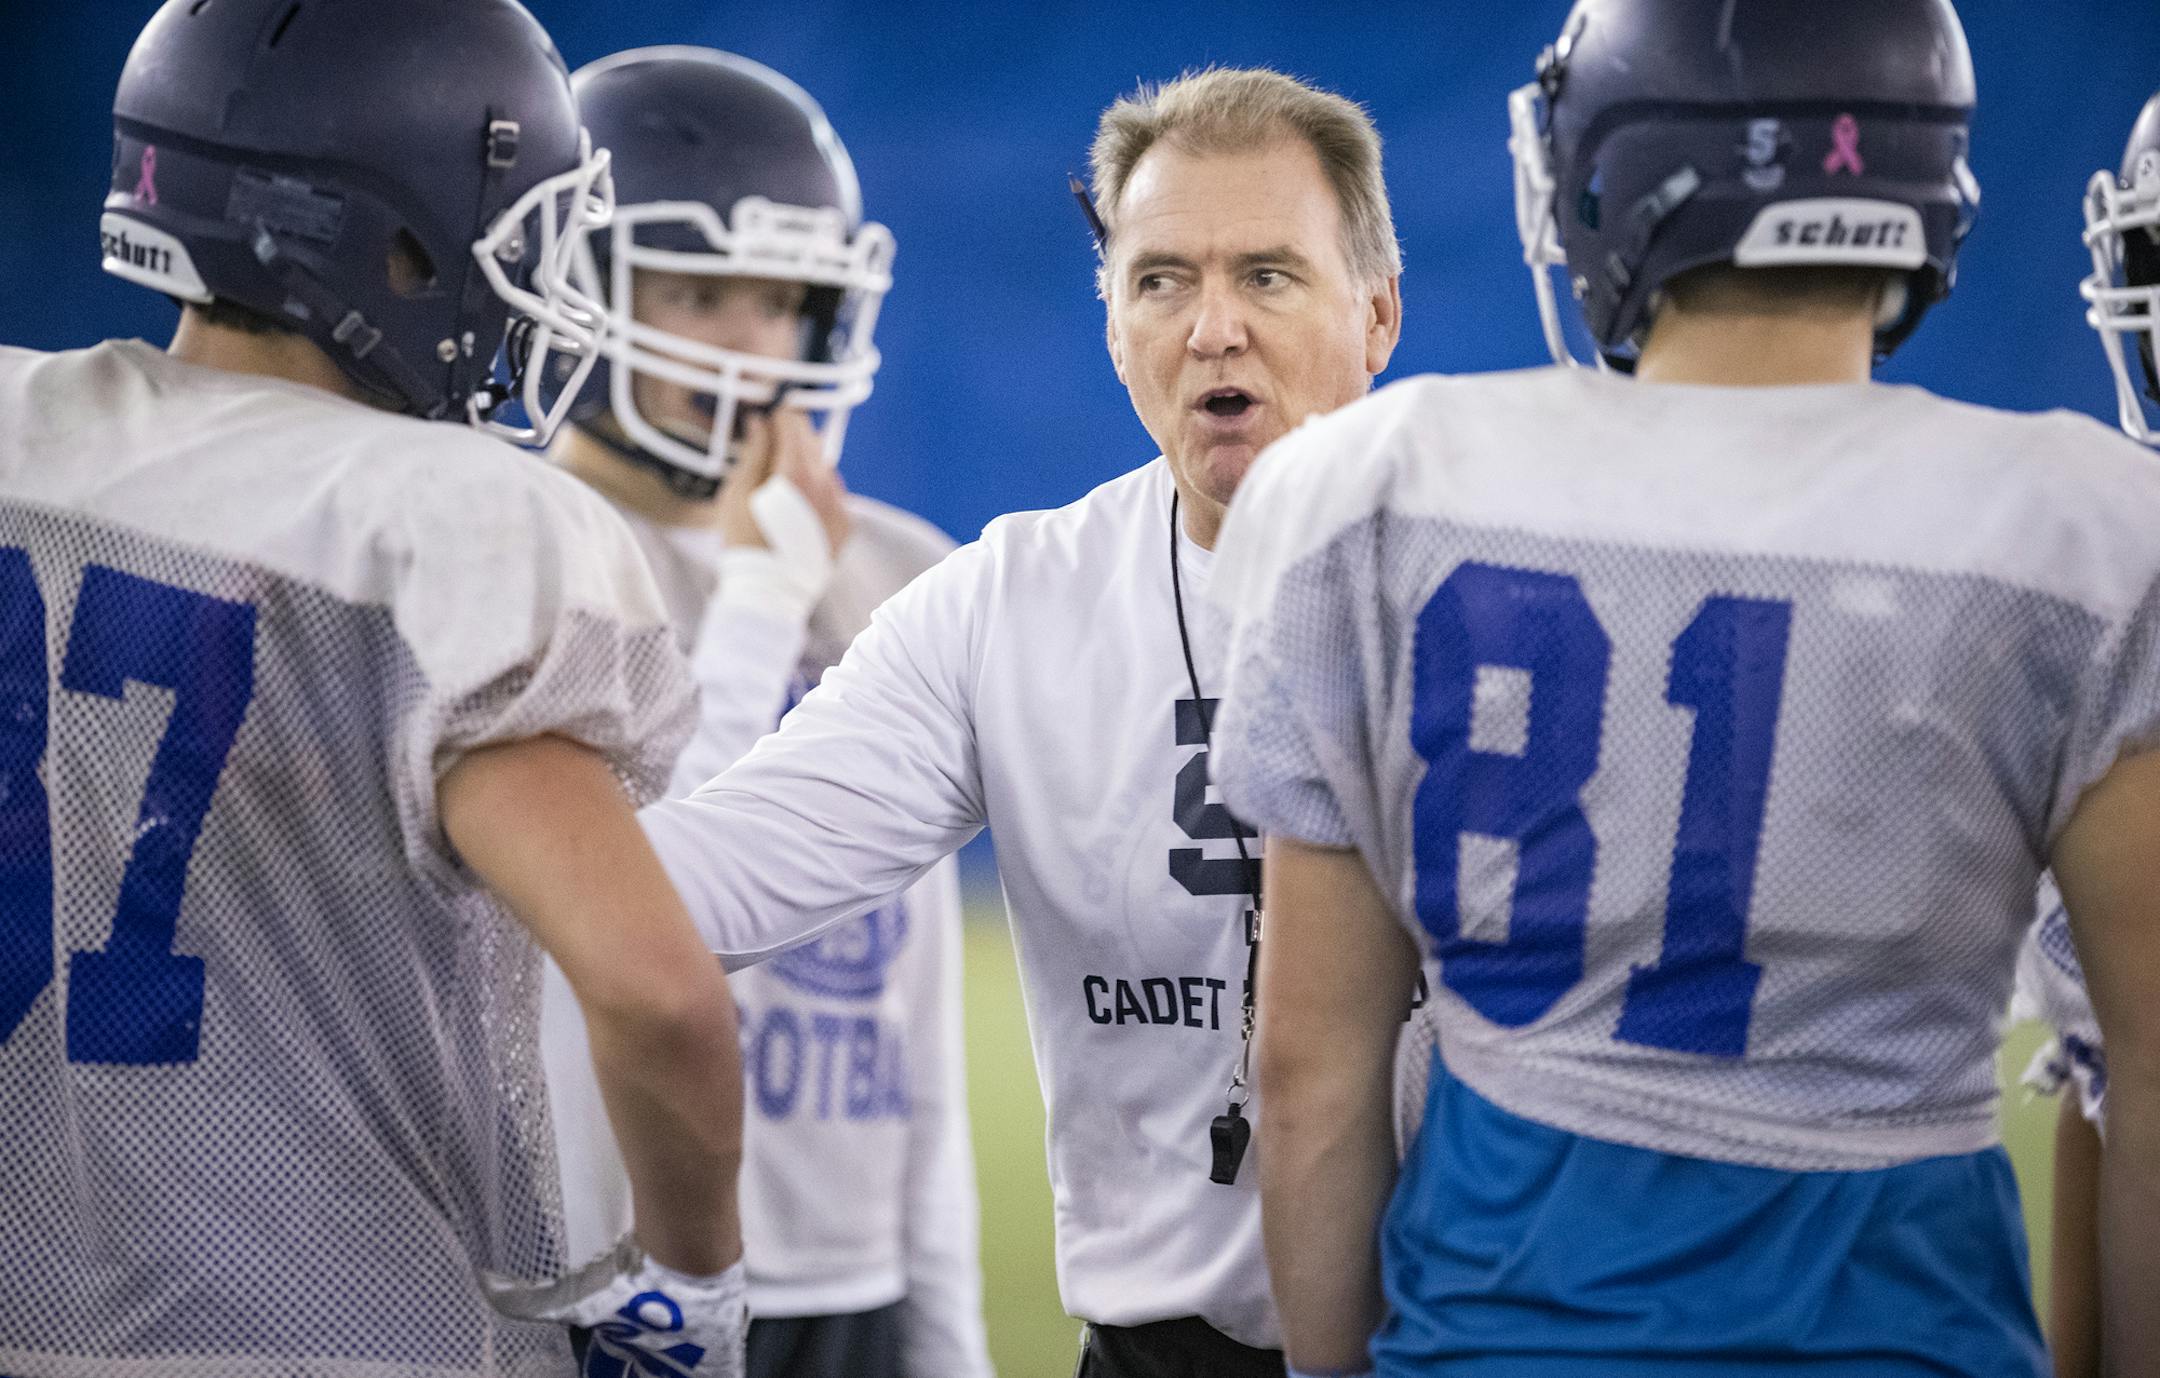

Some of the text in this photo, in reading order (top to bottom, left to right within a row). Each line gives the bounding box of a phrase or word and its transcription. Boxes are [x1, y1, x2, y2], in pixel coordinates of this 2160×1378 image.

[1775, 213, 1907, 247] schutt
[0, 545, 258, 1065] 7
[1410, 558, 1794, 1058] 81
[1083, 974, 1226, 1030] CADET
